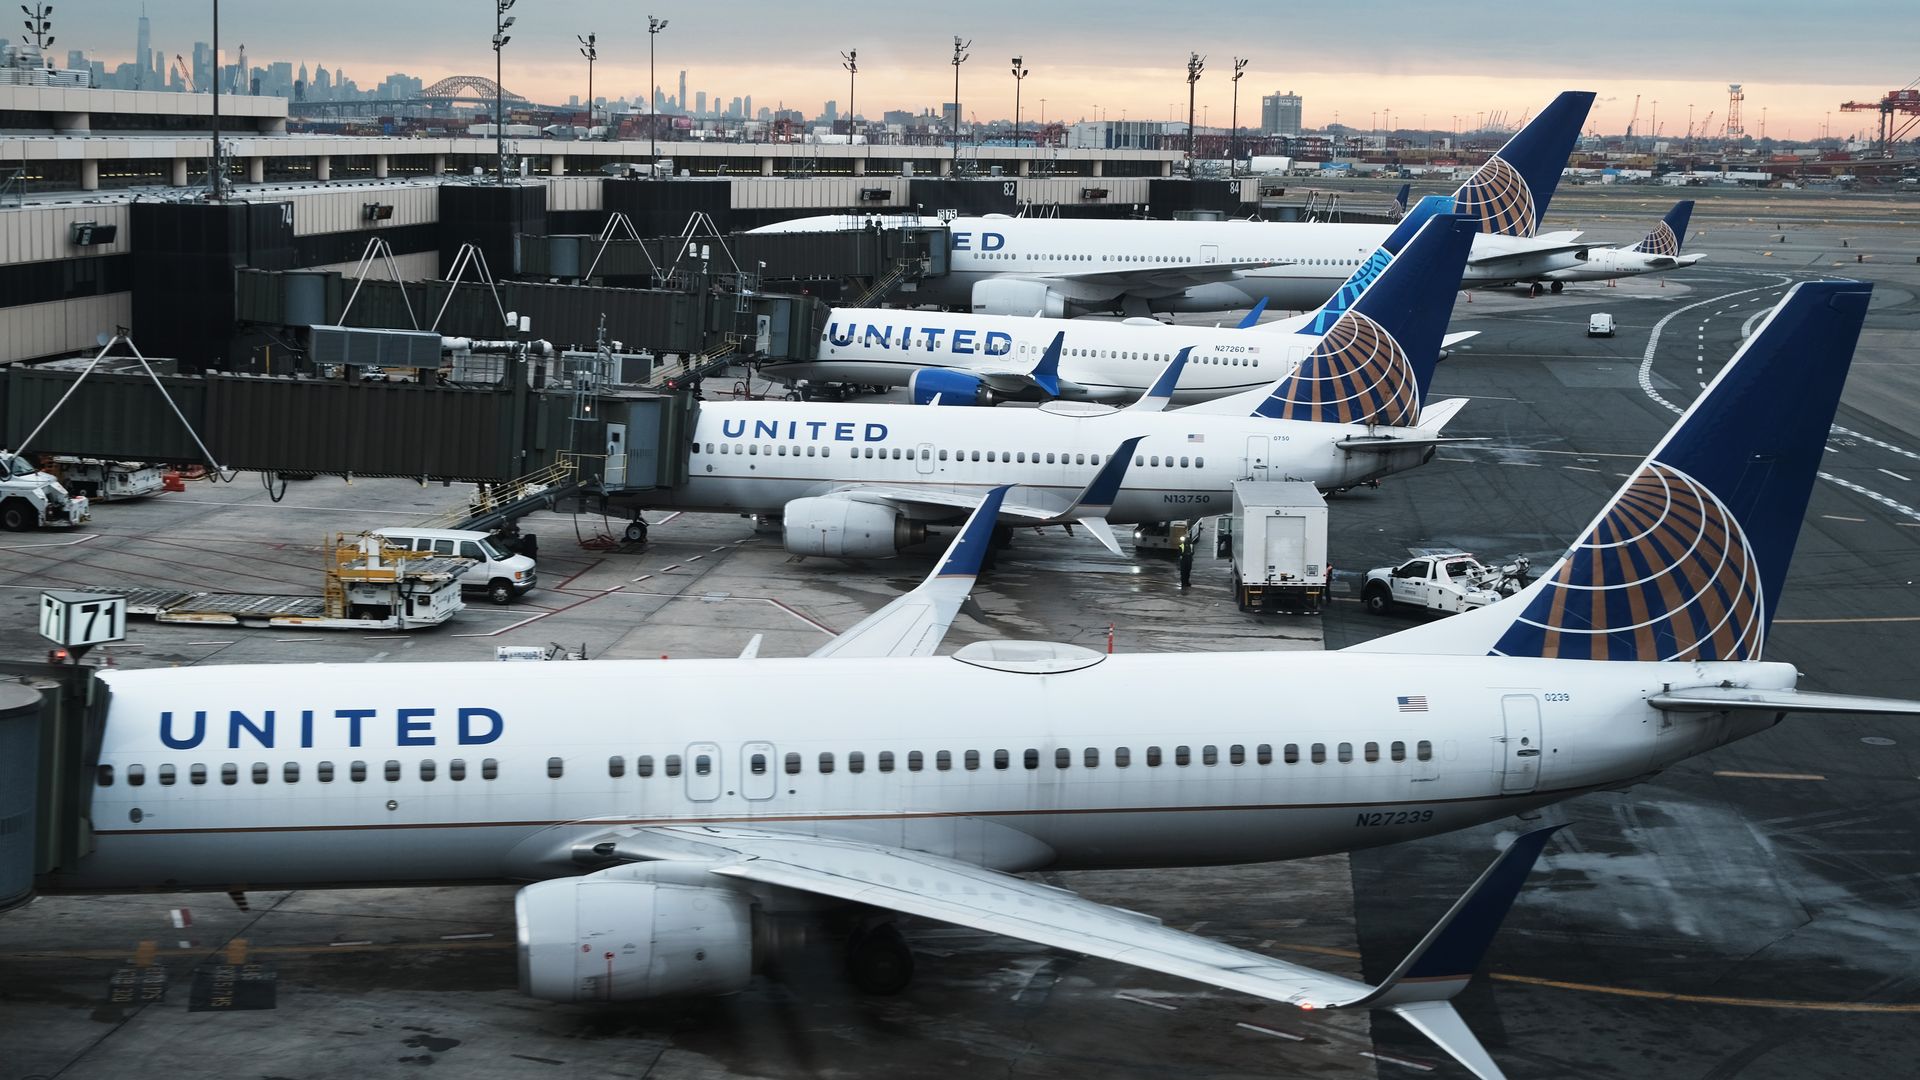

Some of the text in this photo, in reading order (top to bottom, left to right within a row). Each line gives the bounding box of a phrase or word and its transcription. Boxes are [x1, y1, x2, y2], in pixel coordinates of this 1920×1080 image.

[1003, 182, 1015, 197] 82
[1230, 182, 1240, 194] 84
[280, 204, 293, 228] 74
[947, 209, 957, 220] 75
[829, 322, 1012, 356] UNITED
[1214, 345, 1246, 353] N27260
[722, 419, 888, 442] UNITED
[1163, 494, 1210, 504] N13750
[46, 598, 61, 641] 71
[81, 601, 116, 642] 71
[1544, 693, 1570, 702] 0239
[159, 707, 504, 750] UNITED
[1355, 810, 1434, 827] N27239
